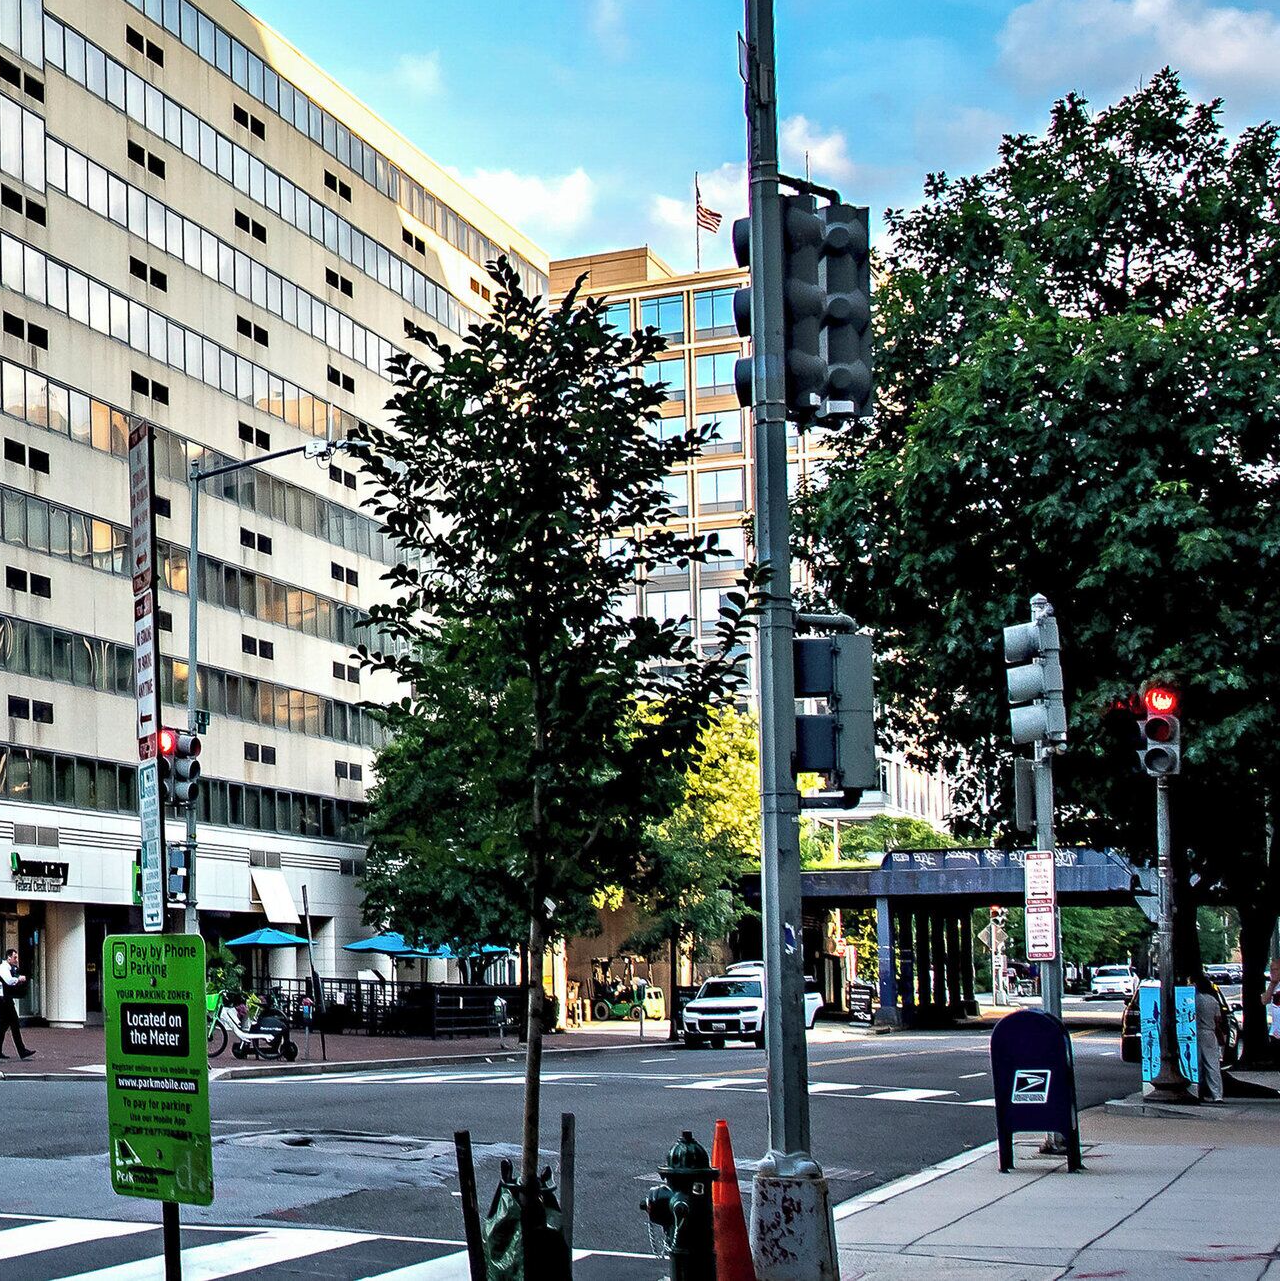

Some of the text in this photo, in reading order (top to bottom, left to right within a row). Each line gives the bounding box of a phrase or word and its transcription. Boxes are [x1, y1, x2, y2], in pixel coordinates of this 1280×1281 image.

[130, 944, 197, 961] Pay by Phone
[130, 961, 168, 978] Parking
[116, 989, 134, 999] YOUR
[135, 989, 166, 1000] PARKING
[127, 1010, 182, 1027] Located on
[130, 1028, 180, 1046] the Meter
[118, 1077, 196, 1091] www.parkmobile.com
[123, 1097, 131, 1107] To
[133, 1099, 146, 1110] pay
[148, 1098, 159, 1109] for
